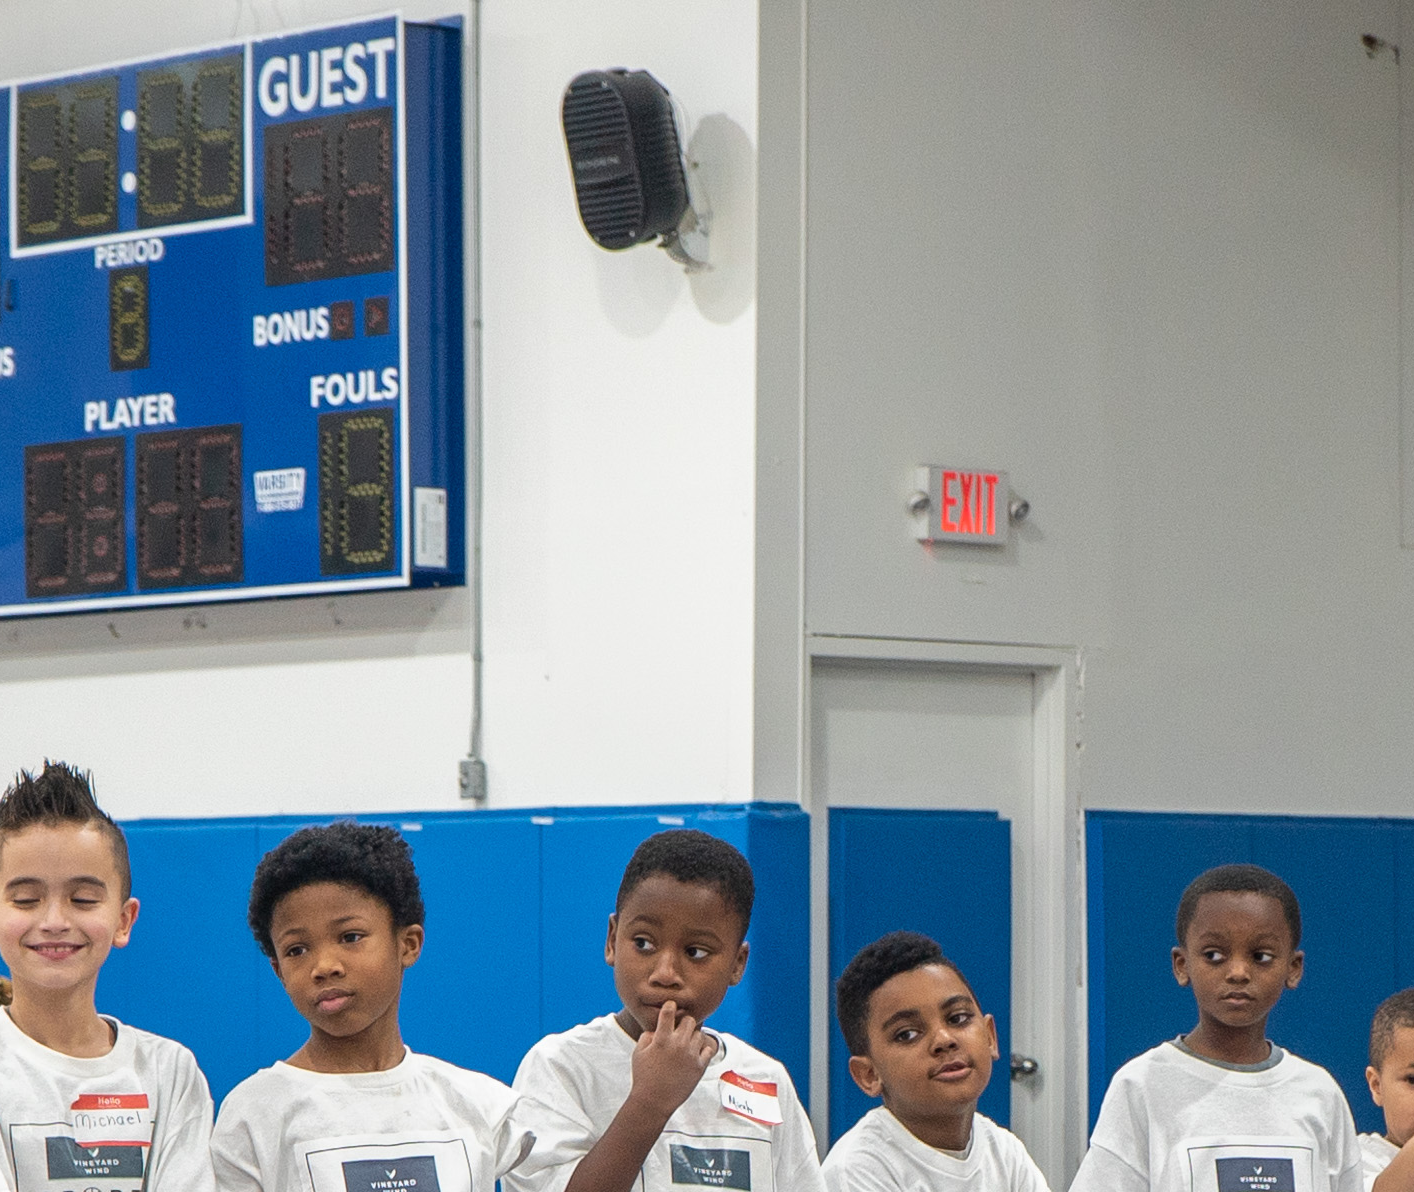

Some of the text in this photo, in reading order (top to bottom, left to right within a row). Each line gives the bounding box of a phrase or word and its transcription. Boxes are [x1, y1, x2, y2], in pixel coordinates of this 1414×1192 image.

[258, 38, 395, 116] GUEST
[95, 239, 163, 269] PERIOD
[253, 307, 330, 346] BONUS
[310, 367, 399, 408] FOULS
[84, 393, 175, 432] PLAYER
[941, 470, 999, 535] EXIT
[75, 1111, 141, 1129] Michael
[73, 1159, 120, 1167] VINEYARD
[370, 1179, 417, 1189] VINEYARD
